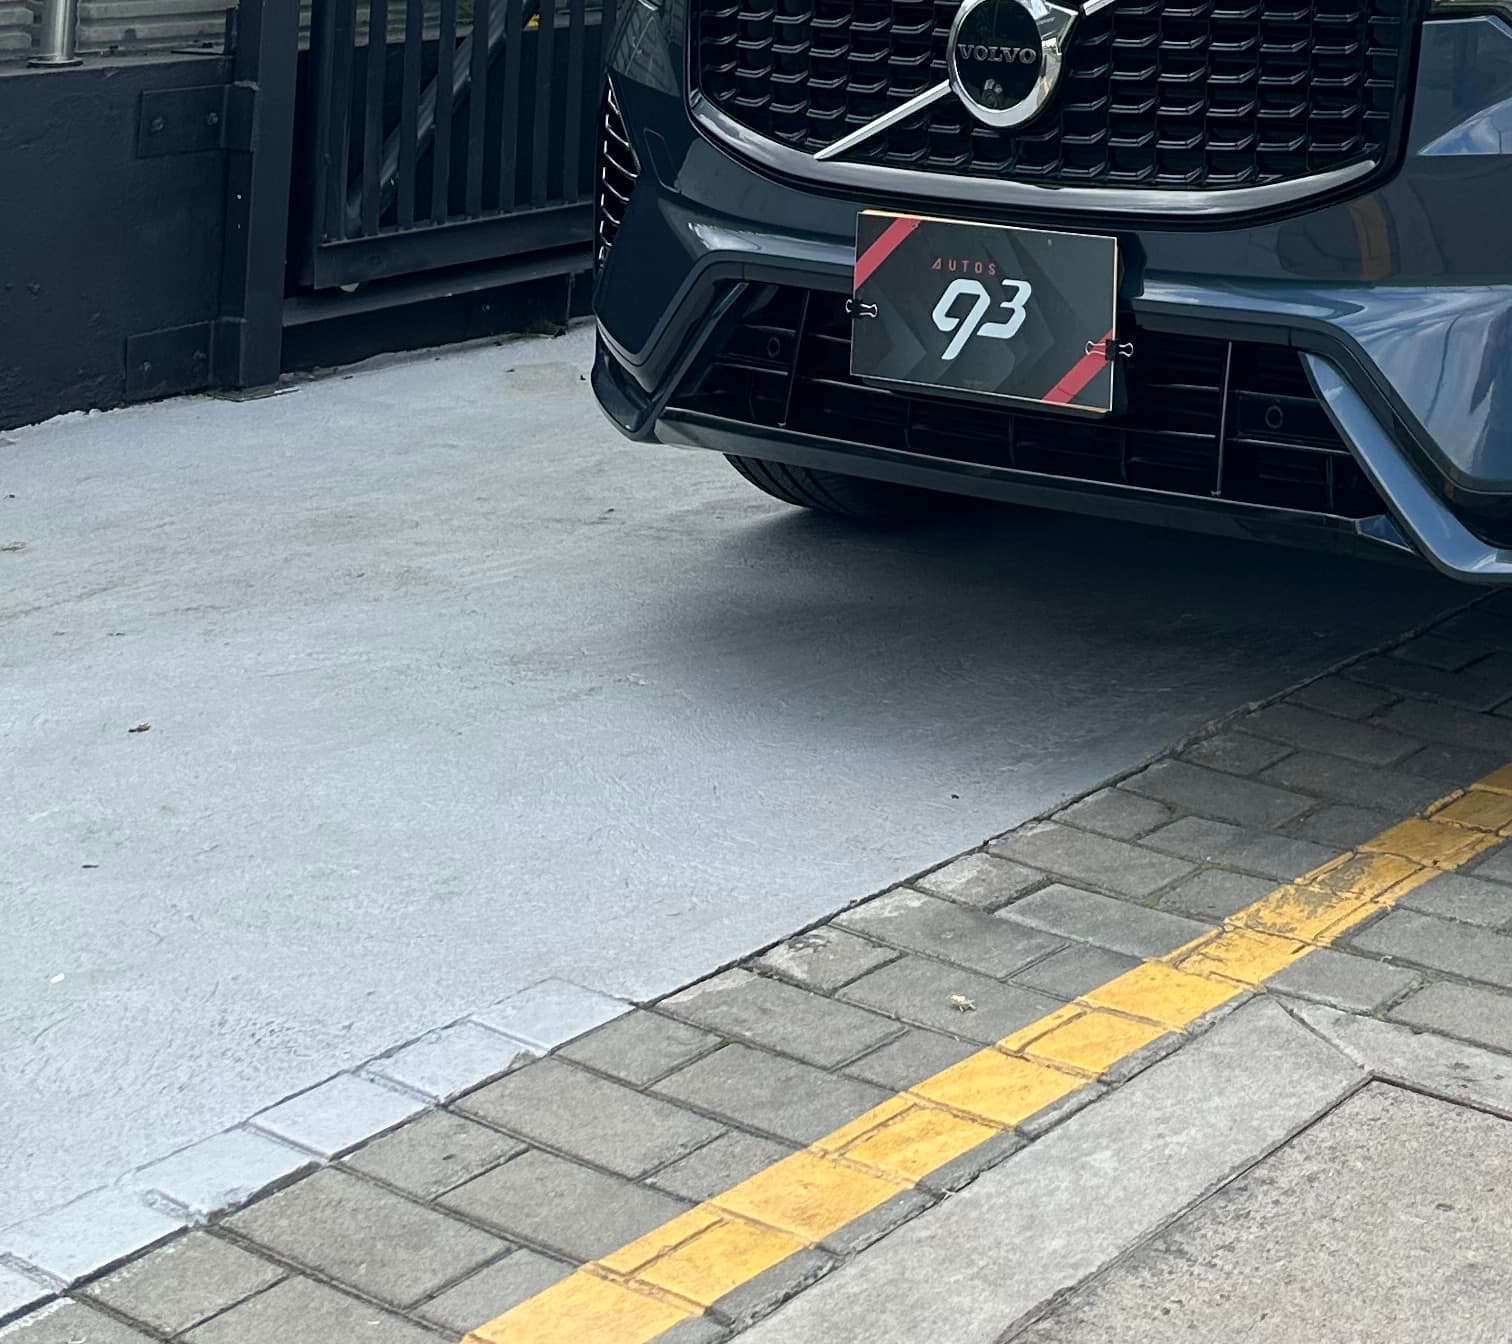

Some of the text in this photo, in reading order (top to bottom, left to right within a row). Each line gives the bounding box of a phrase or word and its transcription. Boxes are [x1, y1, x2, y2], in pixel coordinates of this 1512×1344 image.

[957, 43, 1037, 64] VOLVO
[931, 257, 998, 276] AUTOS
[932, 278, 1033, 360] 93
